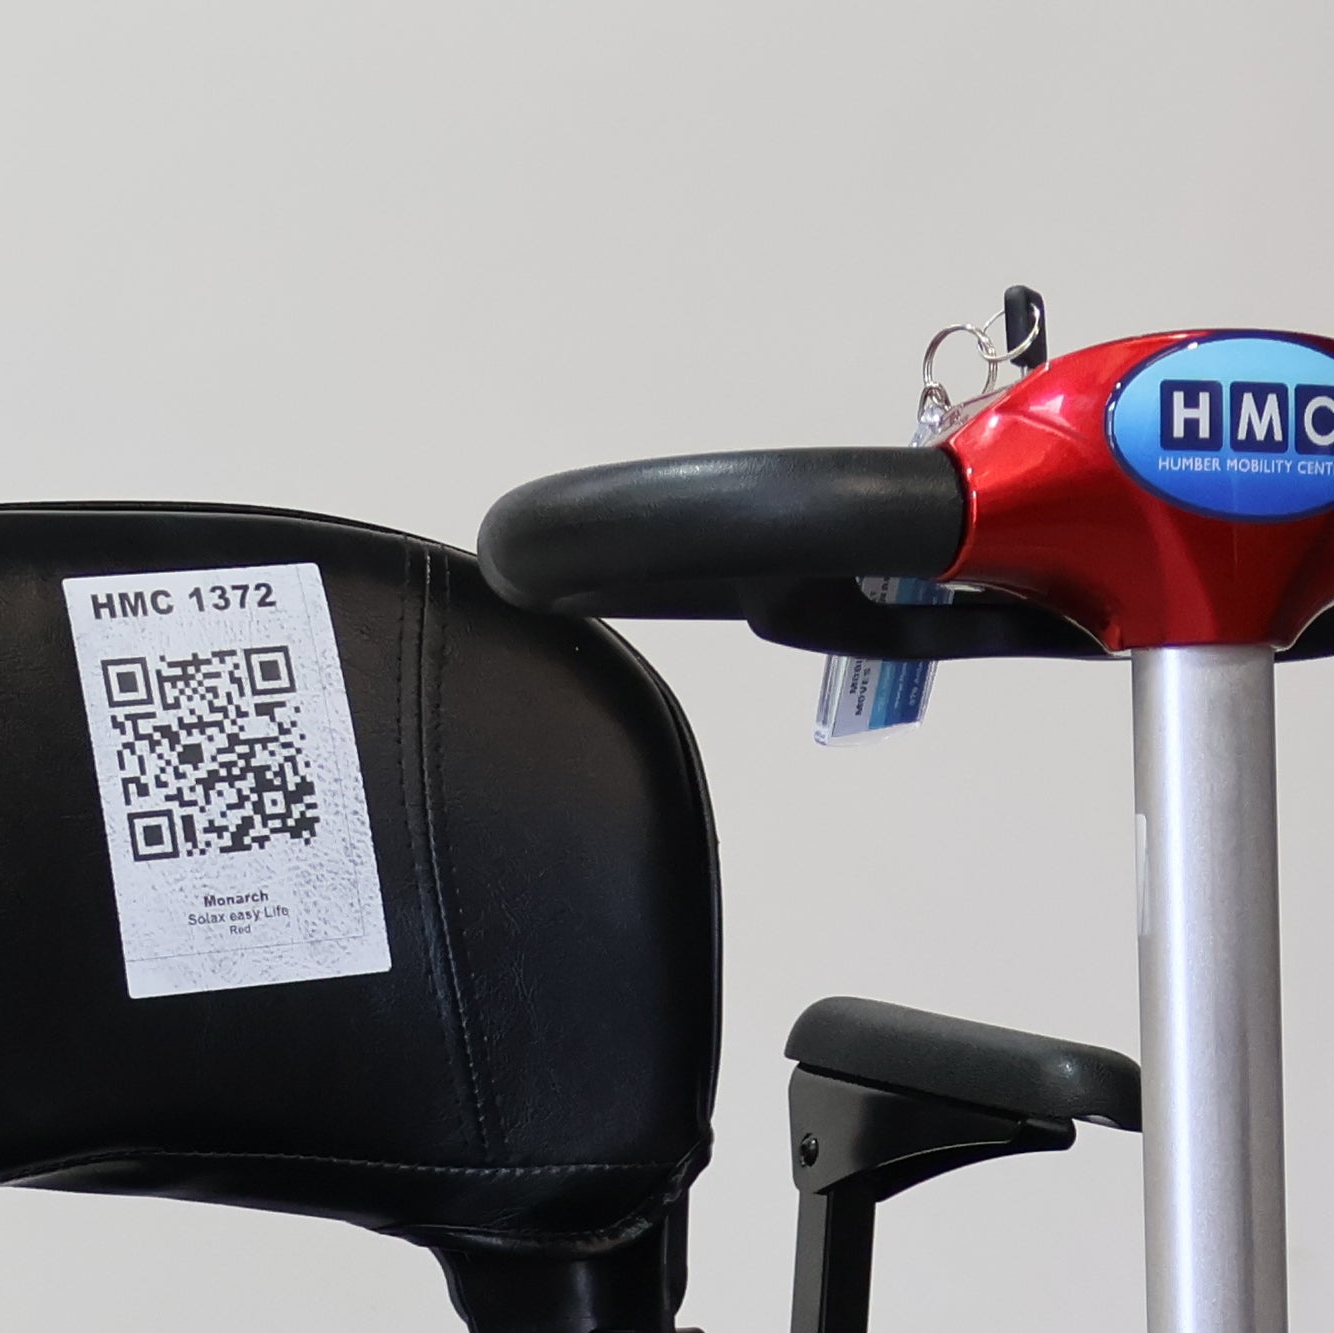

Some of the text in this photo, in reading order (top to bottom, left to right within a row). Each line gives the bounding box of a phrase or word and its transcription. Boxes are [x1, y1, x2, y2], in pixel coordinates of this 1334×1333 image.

[1158, 456, 1221, 472] HUMBER
[1226, 458, 1293, 474] MOBILITY
[91, 582, 277, 620] HMC 1372
[203, 890, 269, 907] Monarch
[187, 904, 290, 926] Solax easy Life
[229, 924, 251, 935] Red
